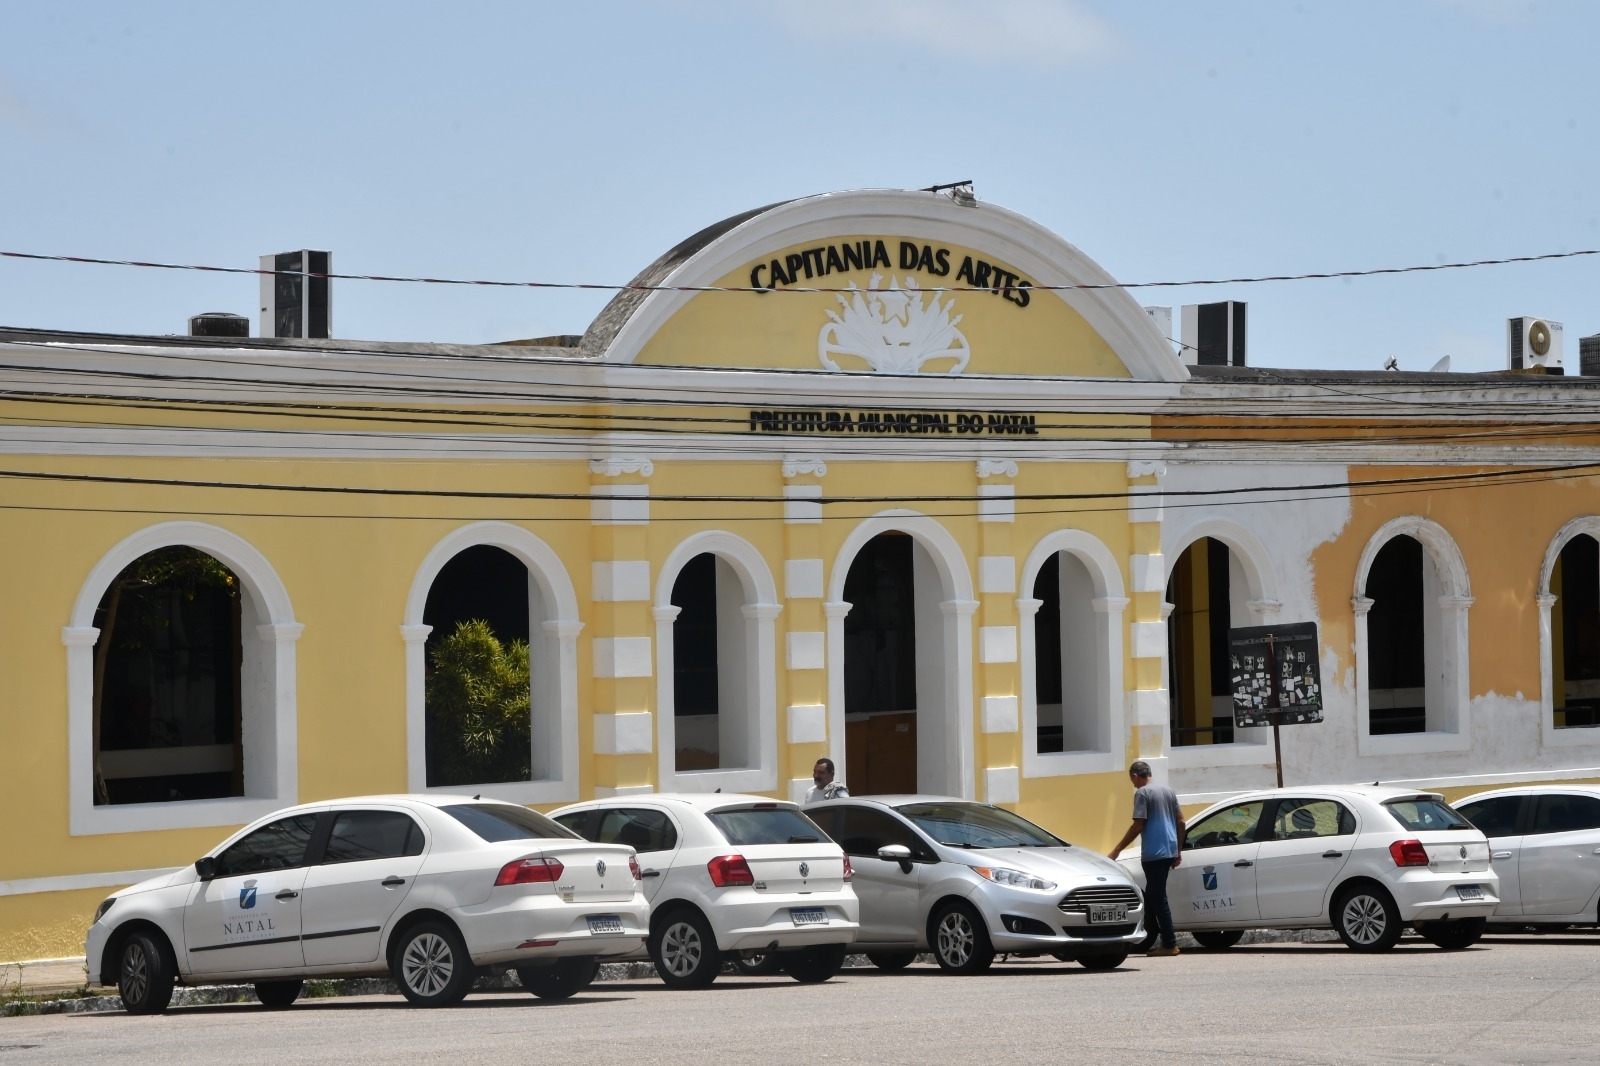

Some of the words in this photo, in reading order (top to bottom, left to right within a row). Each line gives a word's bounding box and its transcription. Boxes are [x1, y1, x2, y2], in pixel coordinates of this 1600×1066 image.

[751, 240, 891, 293] CAPITANIA
[899, 241, 950, 277] DAS
[956, 256, 1034, 308] ARTES
[750, 411, 855, 431] PREFEITURA
[857, 413, 953, 433] MUNICIPAL
[956, 414, 984, 434] DO
[987, 415, 1039, 435] NATAL
[1192, 898, 1236, 911] NATAL
[223, 918, 276, 935] NATAL
